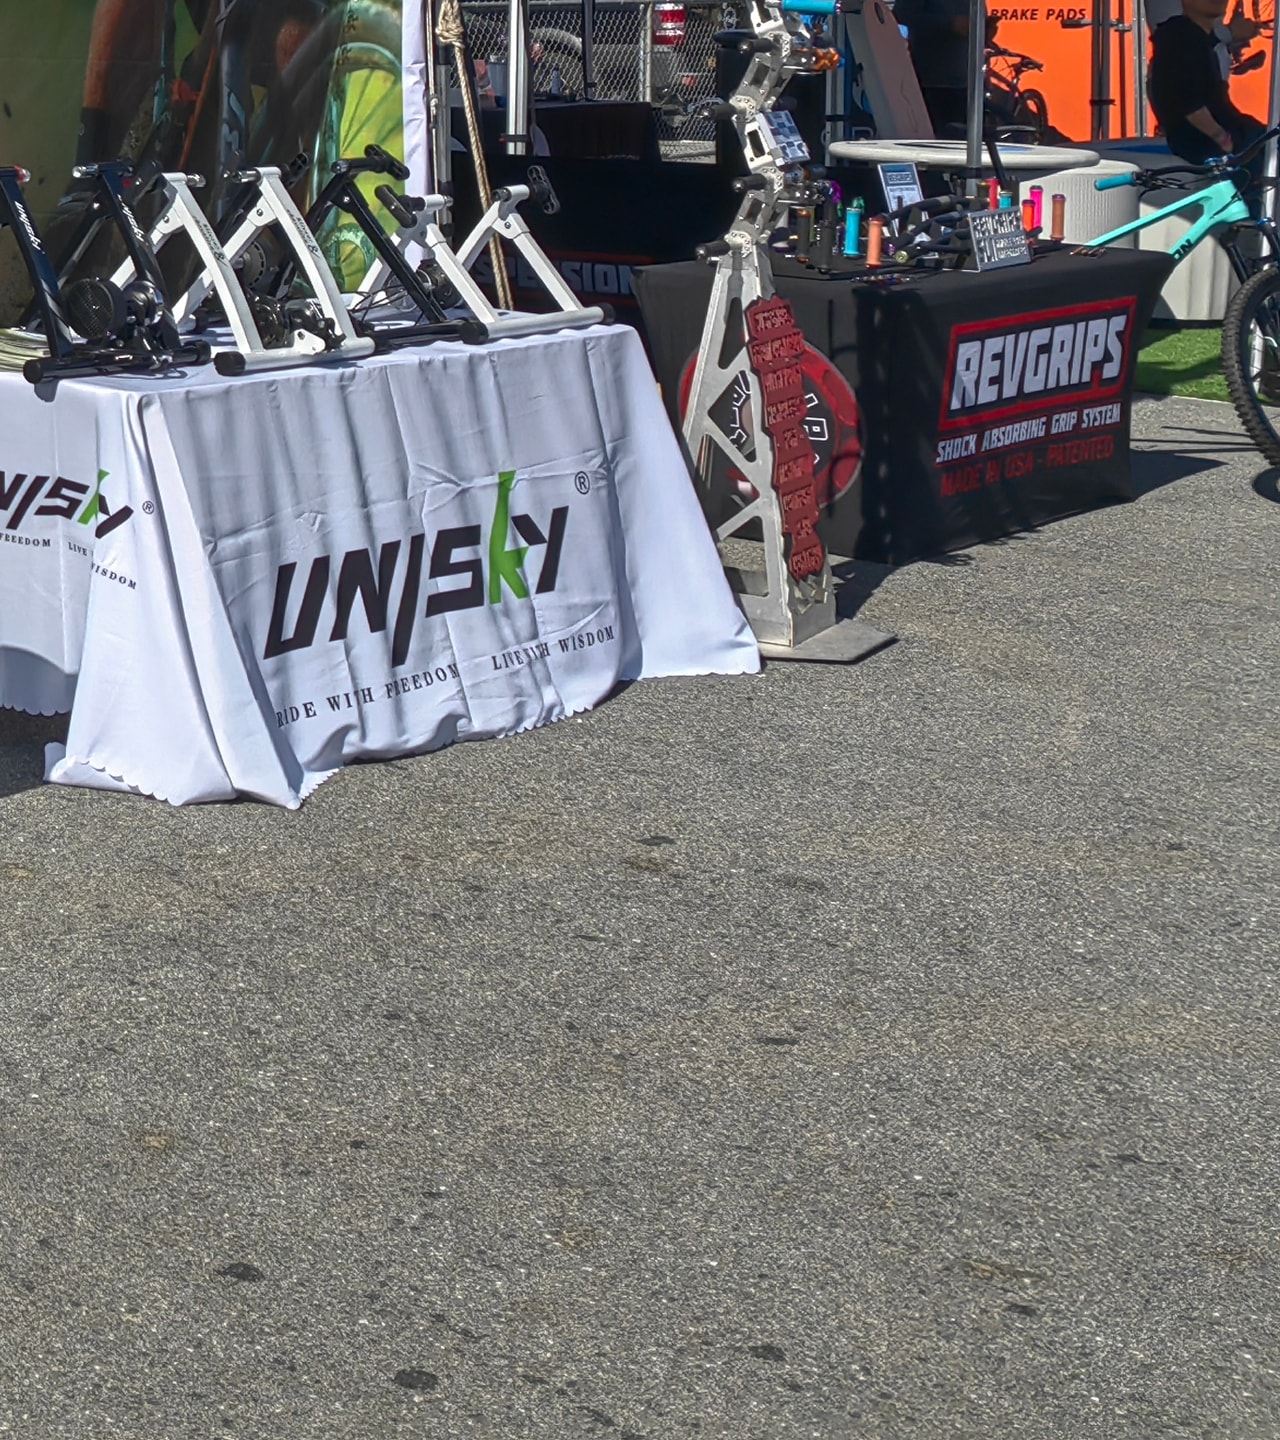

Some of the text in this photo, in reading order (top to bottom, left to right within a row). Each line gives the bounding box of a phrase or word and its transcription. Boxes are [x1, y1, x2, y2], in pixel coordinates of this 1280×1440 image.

[1046, 8, 1087, 21] PADS
[950, 315, 1127, 410] REVGRIPS
[936, 402, 1122, 464] SHOCK ABSORBING GRIP SYSTEM
[941, 463, 982, 498] MADE
[1005, 451, 1035, 480] USA
[1047, 434, 1115, 470] PATENTED
[0, 532, 52, 548] FREEDOM
[68, 542, 88, 556] LIVE
[276, 701, 317, 728] RIDE
[558, 625, 615, 655] WISDOM
